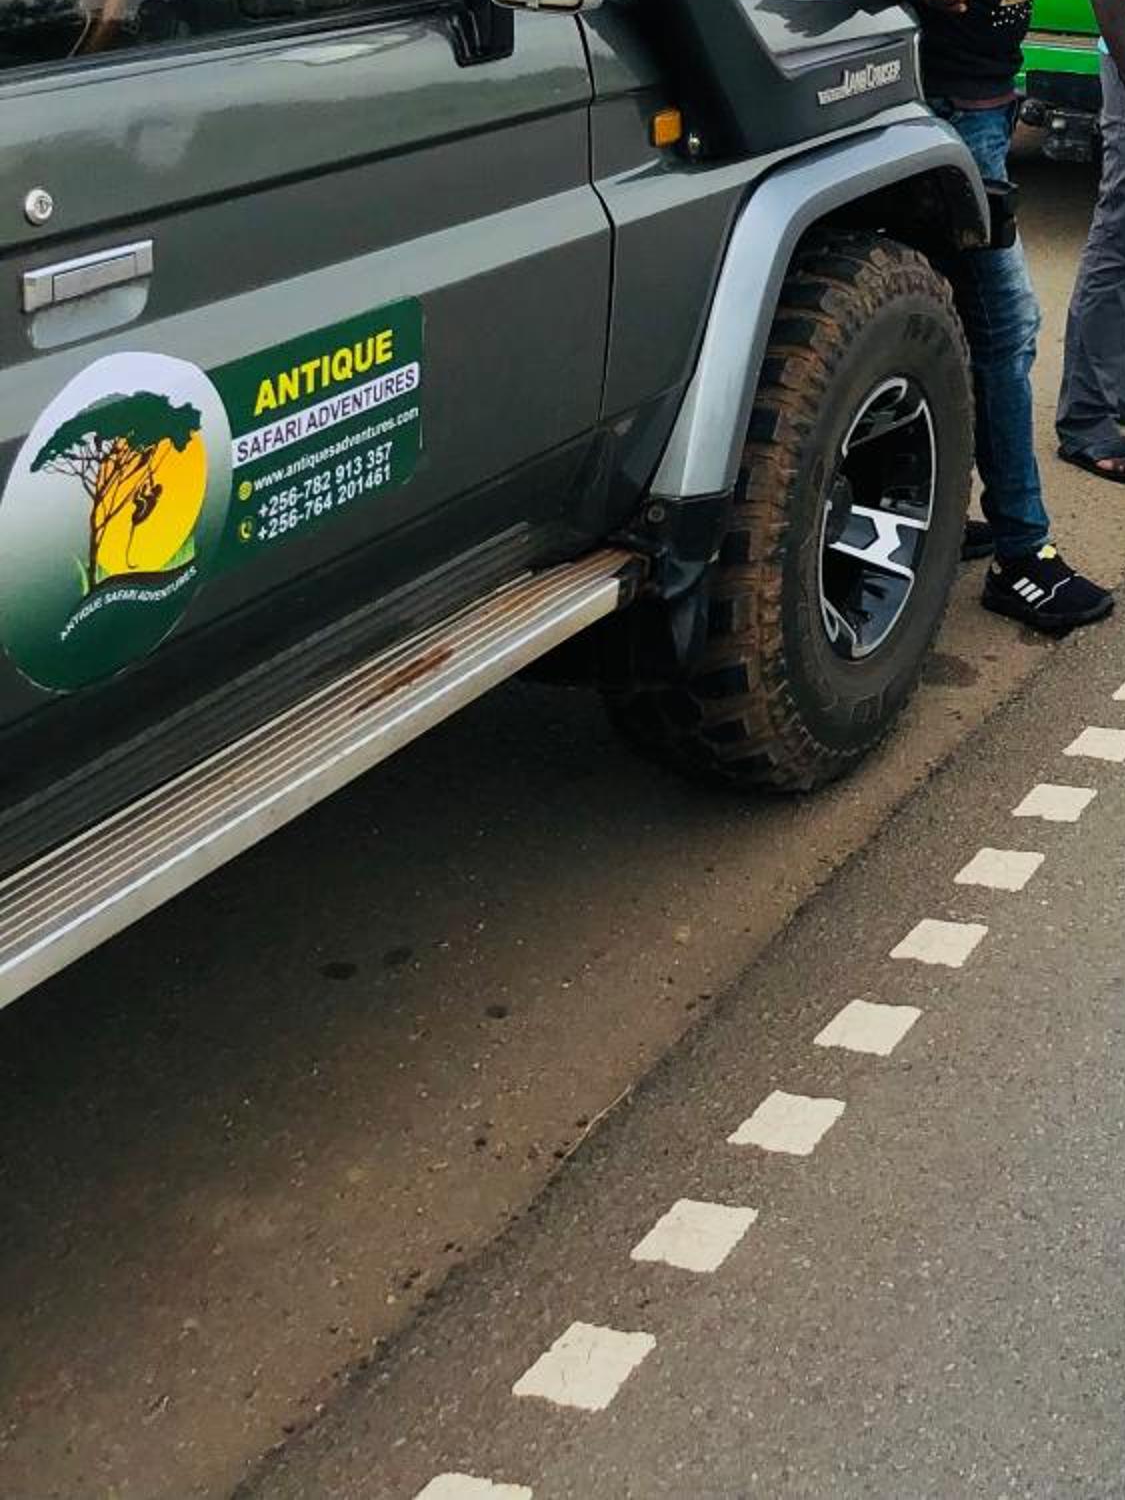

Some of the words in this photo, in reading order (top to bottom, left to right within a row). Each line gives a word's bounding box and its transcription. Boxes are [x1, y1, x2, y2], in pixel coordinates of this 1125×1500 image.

[254, 329, 393, 416] ANTIQUE
[237, 420, 300, 463] SAFARI
[306, 369, 416, 433] ADVENTURES
[254, 407, 419, 491] www.antiquesadventures.com
[257, 471, 331, 519] +256-782
[335, 456, 363, 485] 913
[366, 441, 393, 470] 357
[257, 492, 333, 541] +256-764
[337, 463, 392, 505] 201461
[60, 597, 103, 641] ANTIQUE
[104, 589, 138, 605] SAFARI
